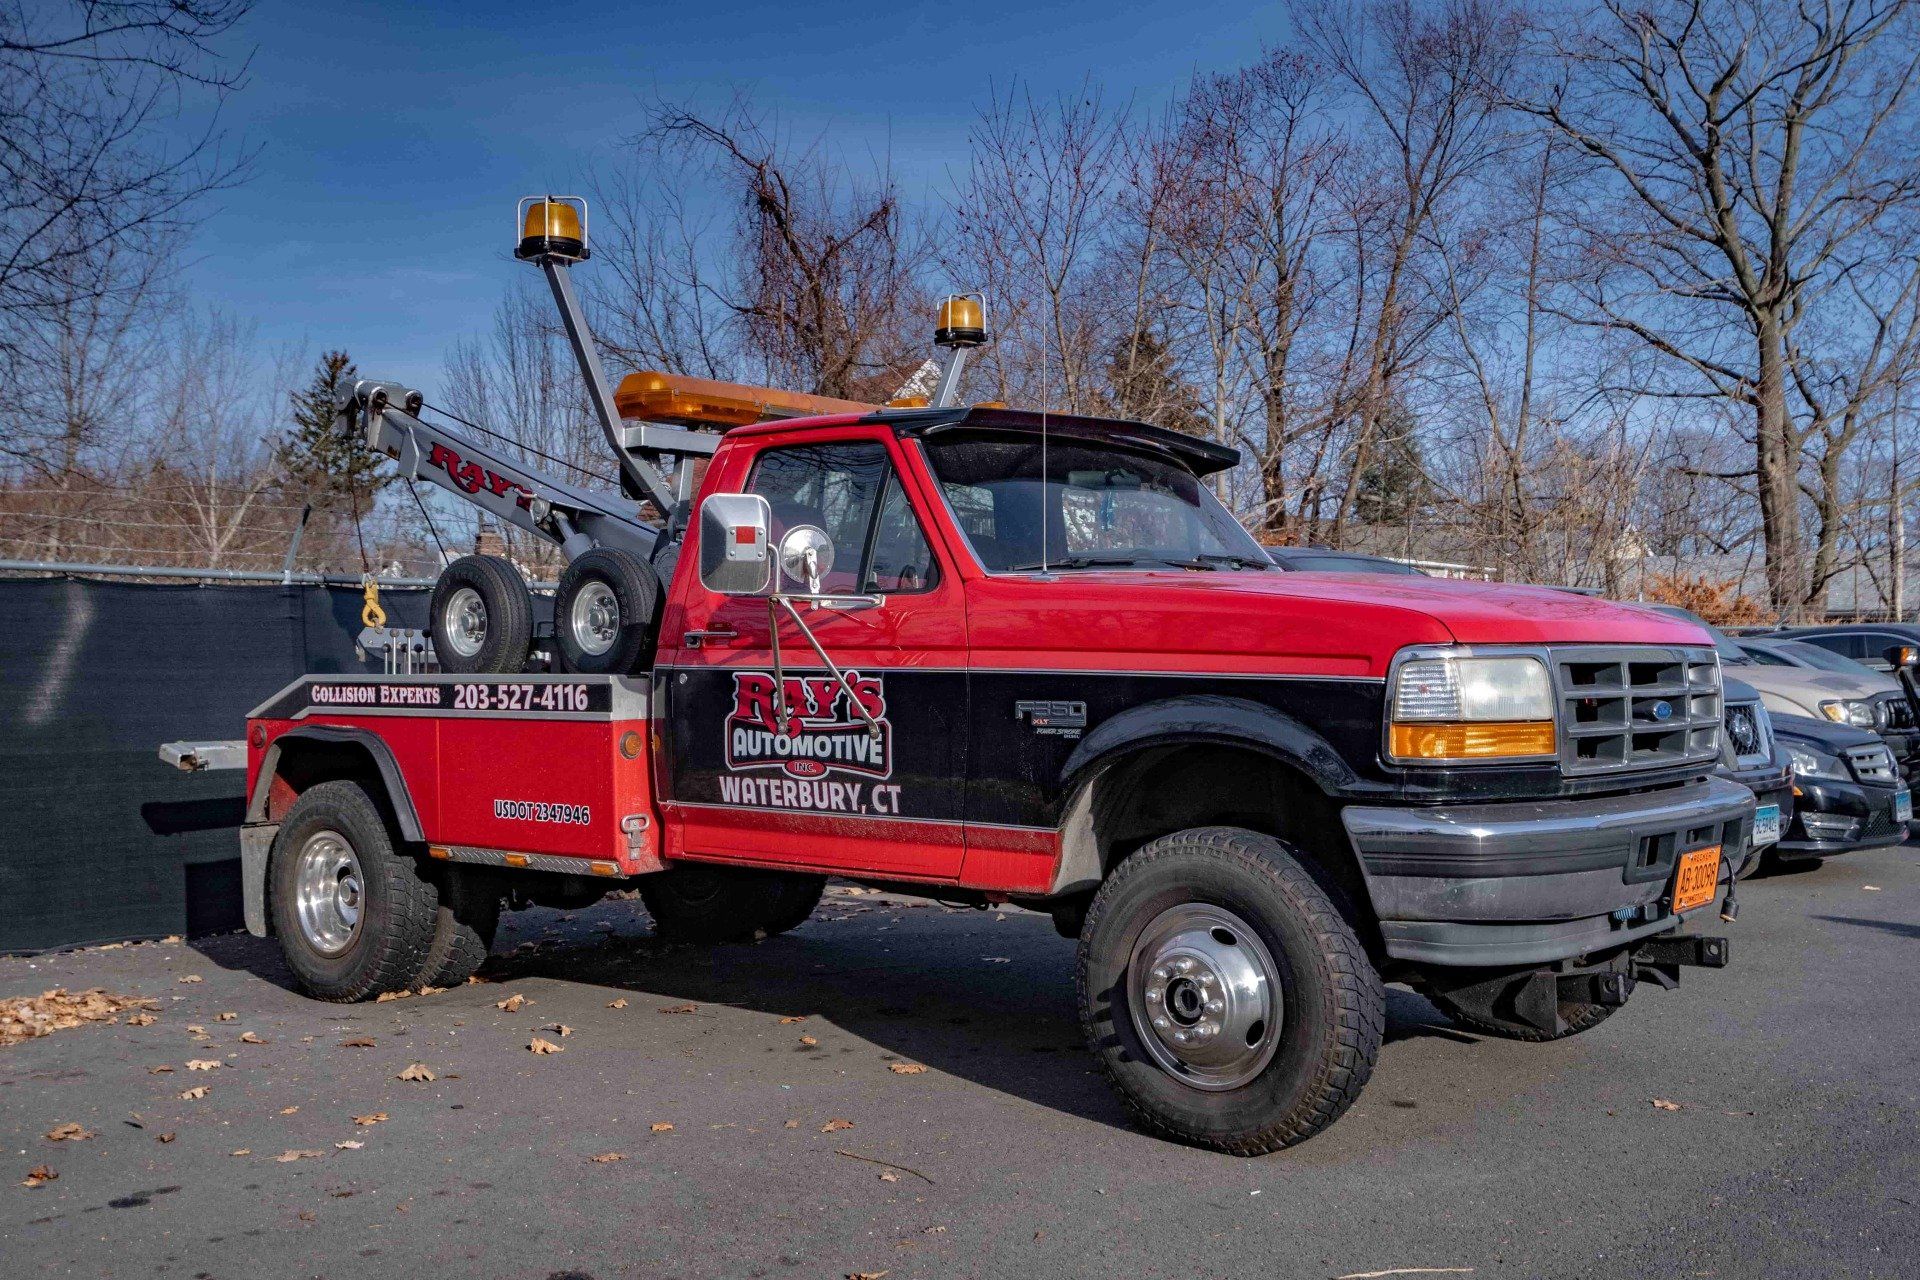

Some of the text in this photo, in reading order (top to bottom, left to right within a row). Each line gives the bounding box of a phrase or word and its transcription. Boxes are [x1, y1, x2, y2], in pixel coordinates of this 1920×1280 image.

[311, 685, 441, 704] COLLISION EXPERTS
[454, 684, 589, 710] 203-527-4116
[732, 670, 885, 738] RAY'S
[733, 728, 883, 765] AUTOMOTIVE
[719, 776, 900, 814] WATERBURY, CT
[494, 800, 591, 825] USDOT 2347946
